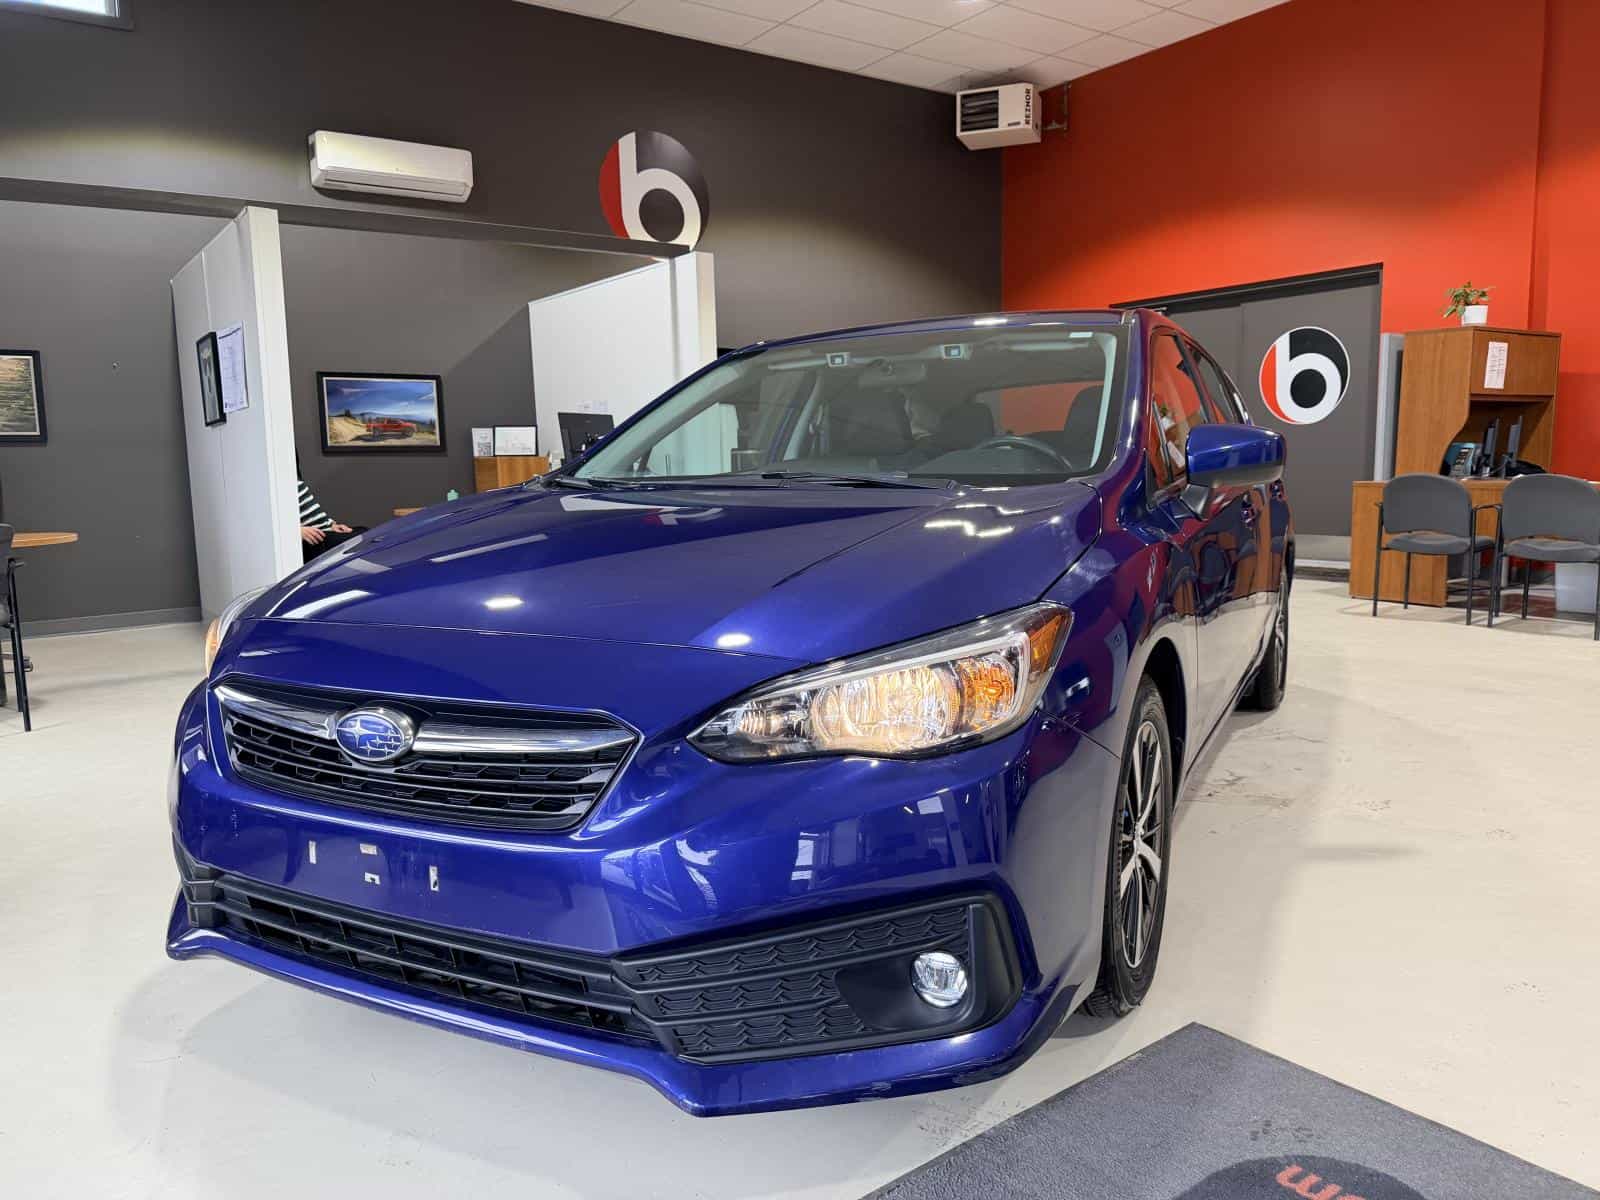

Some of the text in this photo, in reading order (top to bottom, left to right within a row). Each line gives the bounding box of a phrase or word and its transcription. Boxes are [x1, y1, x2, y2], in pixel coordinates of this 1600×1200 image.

[1024, 88, 1032, 125] REZNOR
[618, 131, 701, 251] b
[1275, 331, 1342, 424] b
